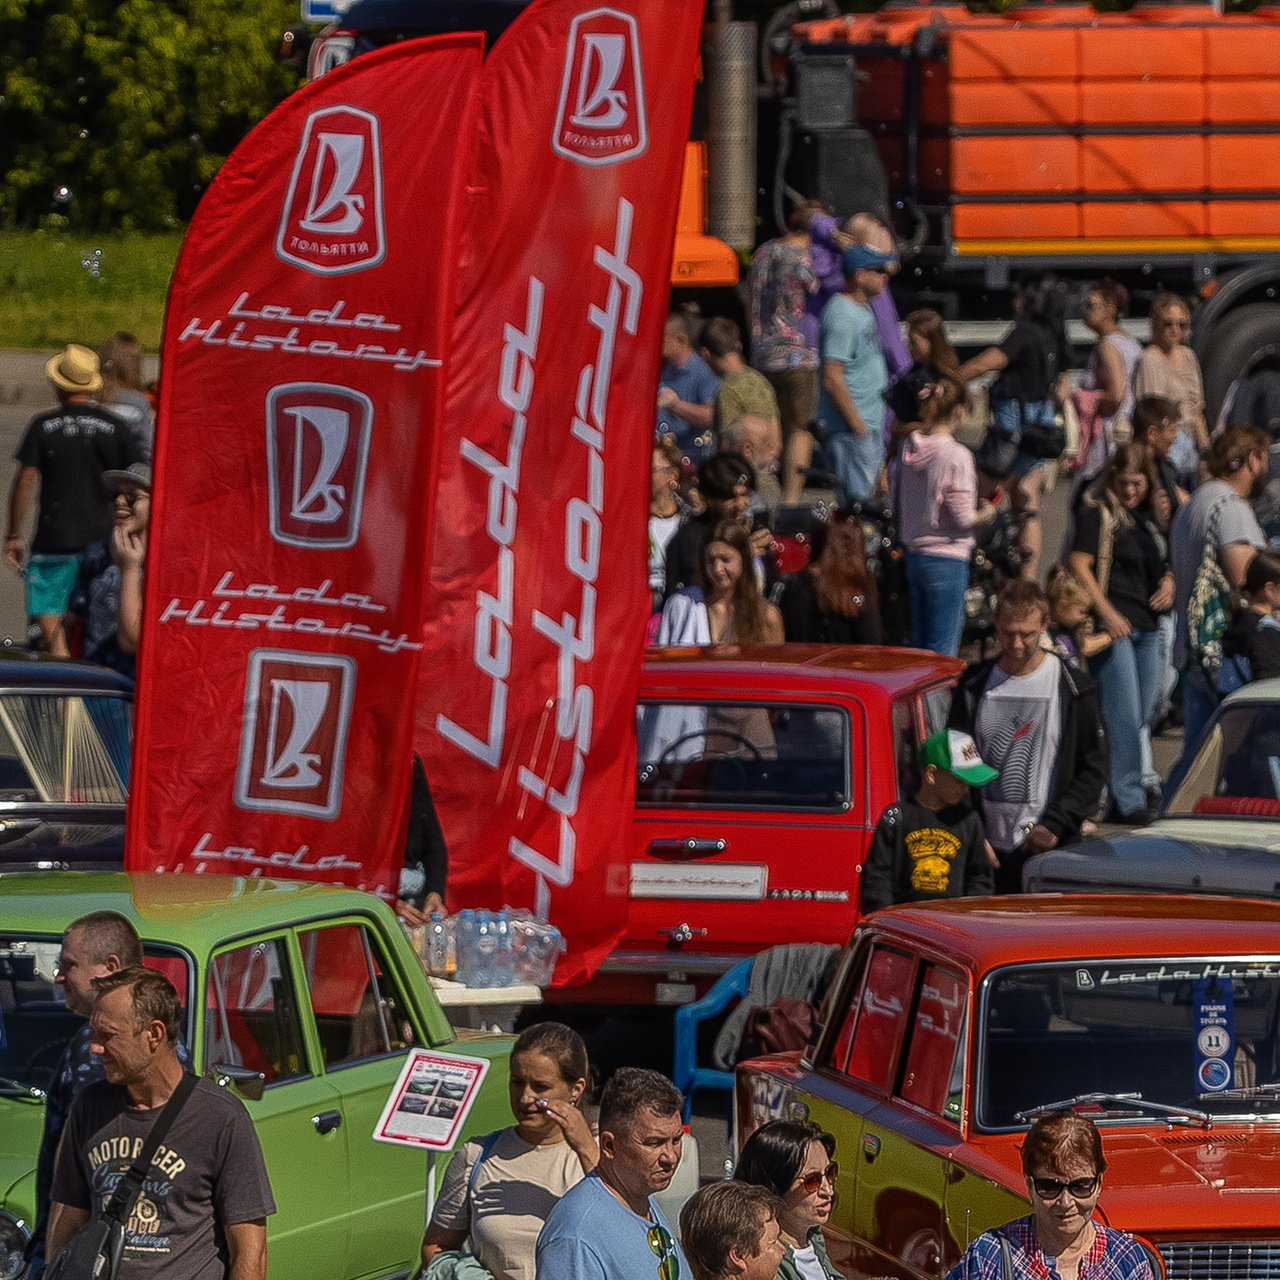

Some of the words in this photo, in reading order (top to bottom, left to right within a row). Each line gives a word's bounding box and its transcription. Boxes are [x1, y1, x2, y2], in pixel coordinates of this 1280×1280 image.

[228, 291, 402, 332] Lada
[178, 317, 443, 371] History
[436, 275, 546, 769] Lada
[212, 570, 387, 613] Lada
[158, 598, 423, 653] History
[190, 832, 363, 871] Lada
[1100, 966, 1201, 985] Lada
[1207, 1035, 1221, 1048] 11
[132, 1137, 187, 1180] RCER
